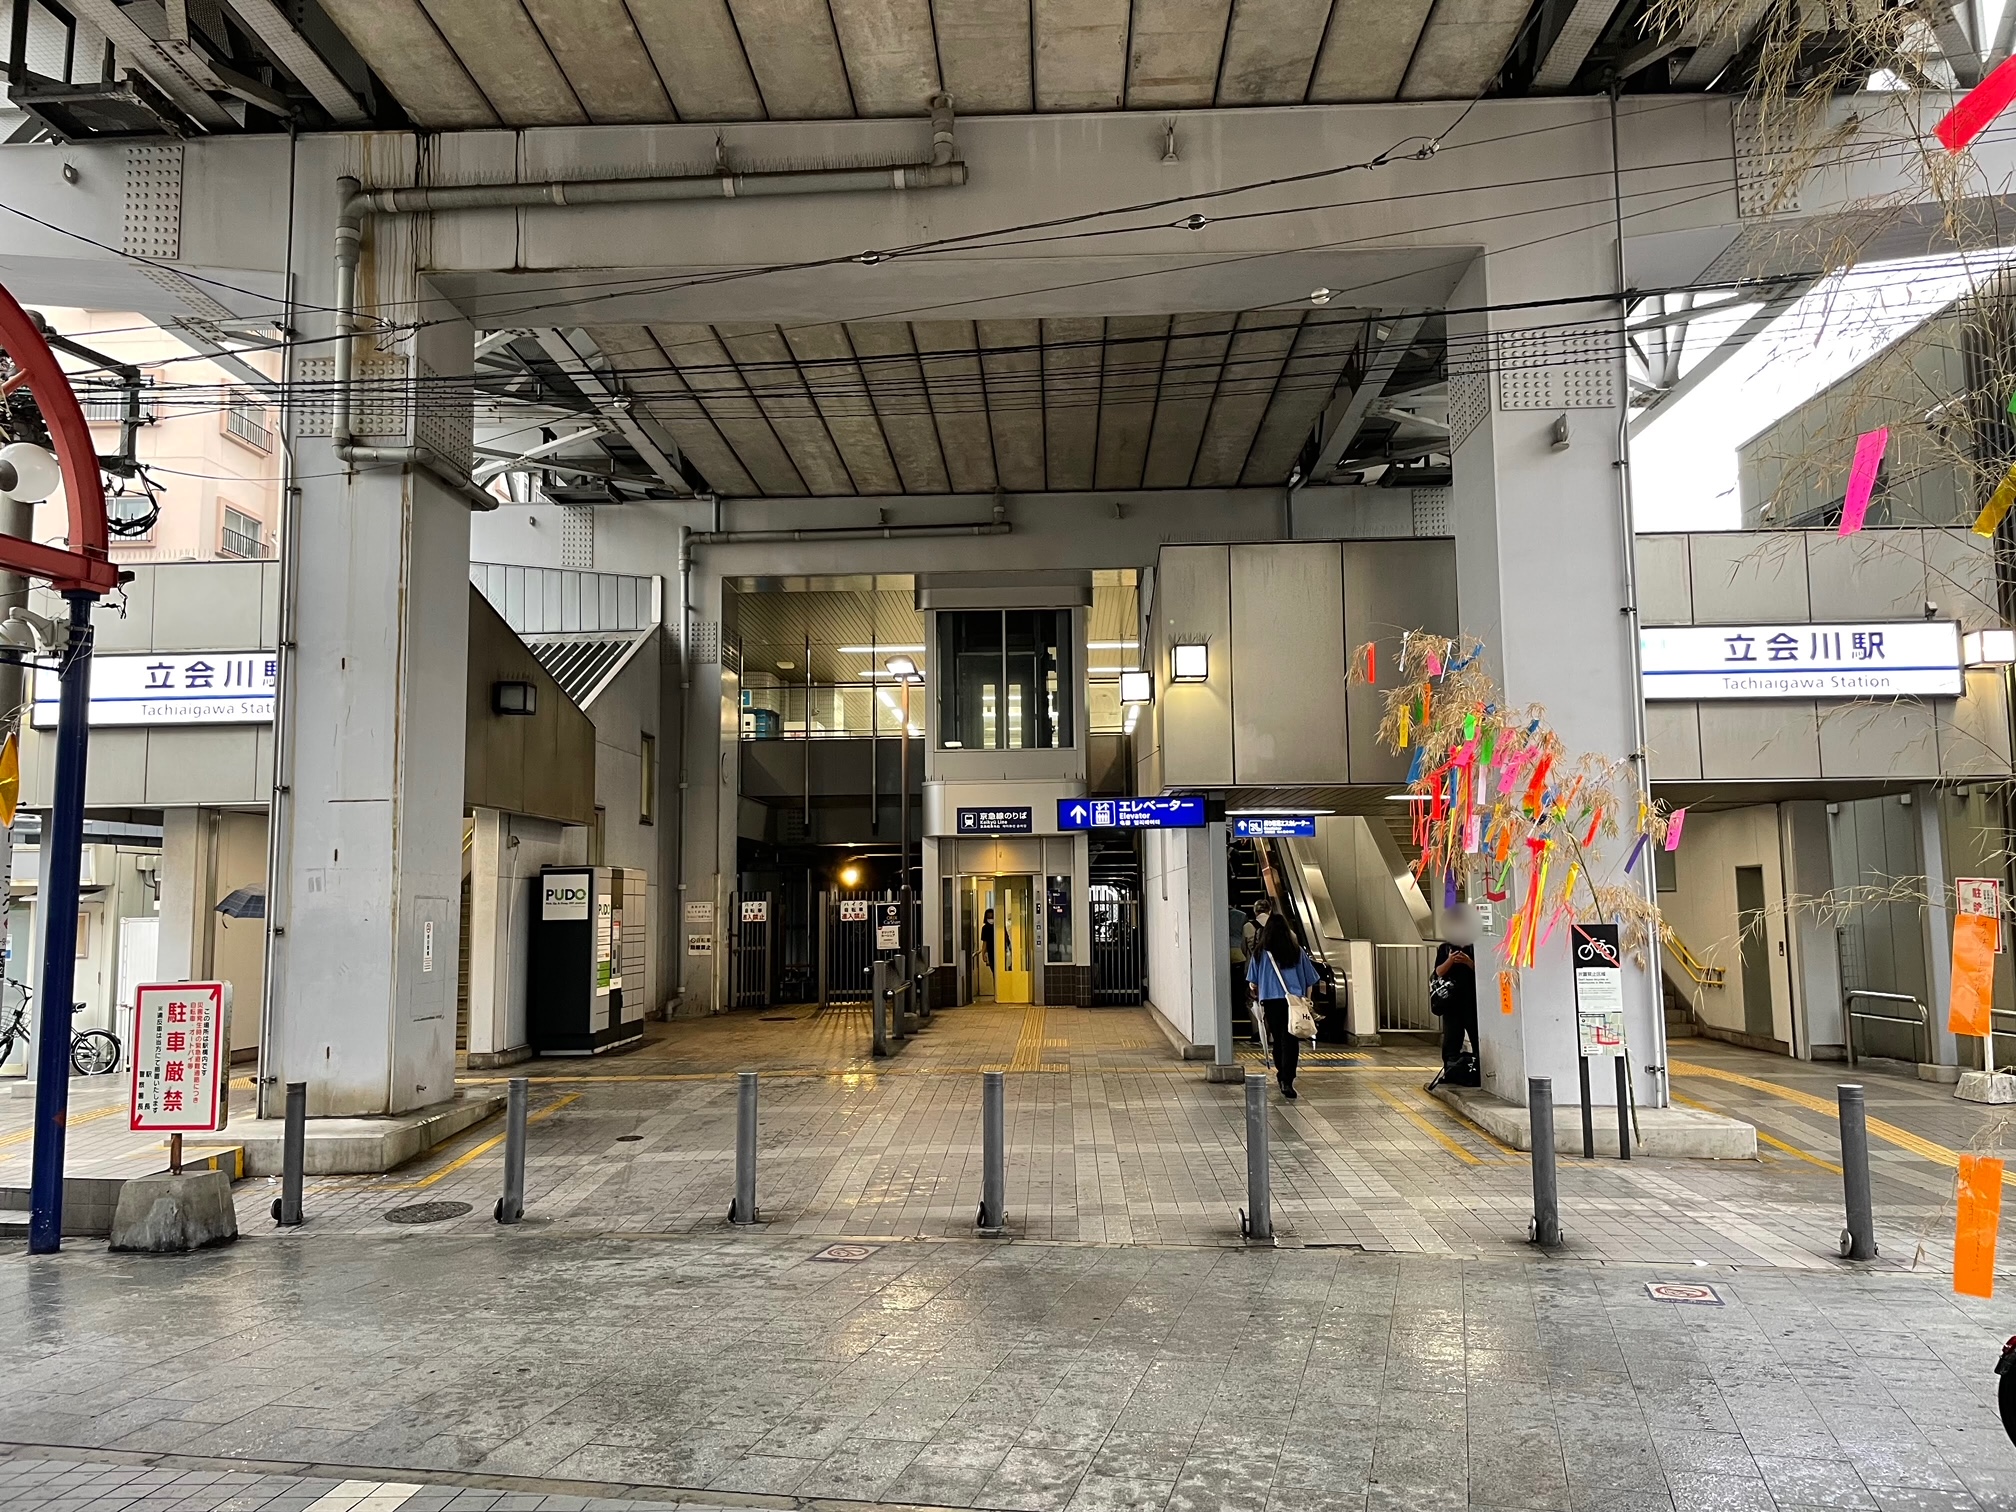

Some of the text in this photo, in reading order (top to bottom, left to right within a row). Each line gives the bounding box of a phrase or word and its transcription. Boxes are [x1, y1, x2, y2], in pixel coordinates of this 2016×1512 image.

[1724, 632, 1885, 661] 立会川駅
[1723, 675, 1890, 692] Tachiaigawa Station
[142, 703, 235, 719] Tachiaigawa
[1118, 799, 1195, 812] エレベーター
[979, 811, 1028, 820] 京急線のりば
[1119, 812, 1151, 820] Elevator
[545, 888, 587, 902] PUDO
[201, 1008, 211, 1076] この場所は駅構内です
[163, 1002, 187, 1112] 駐車厳禁
